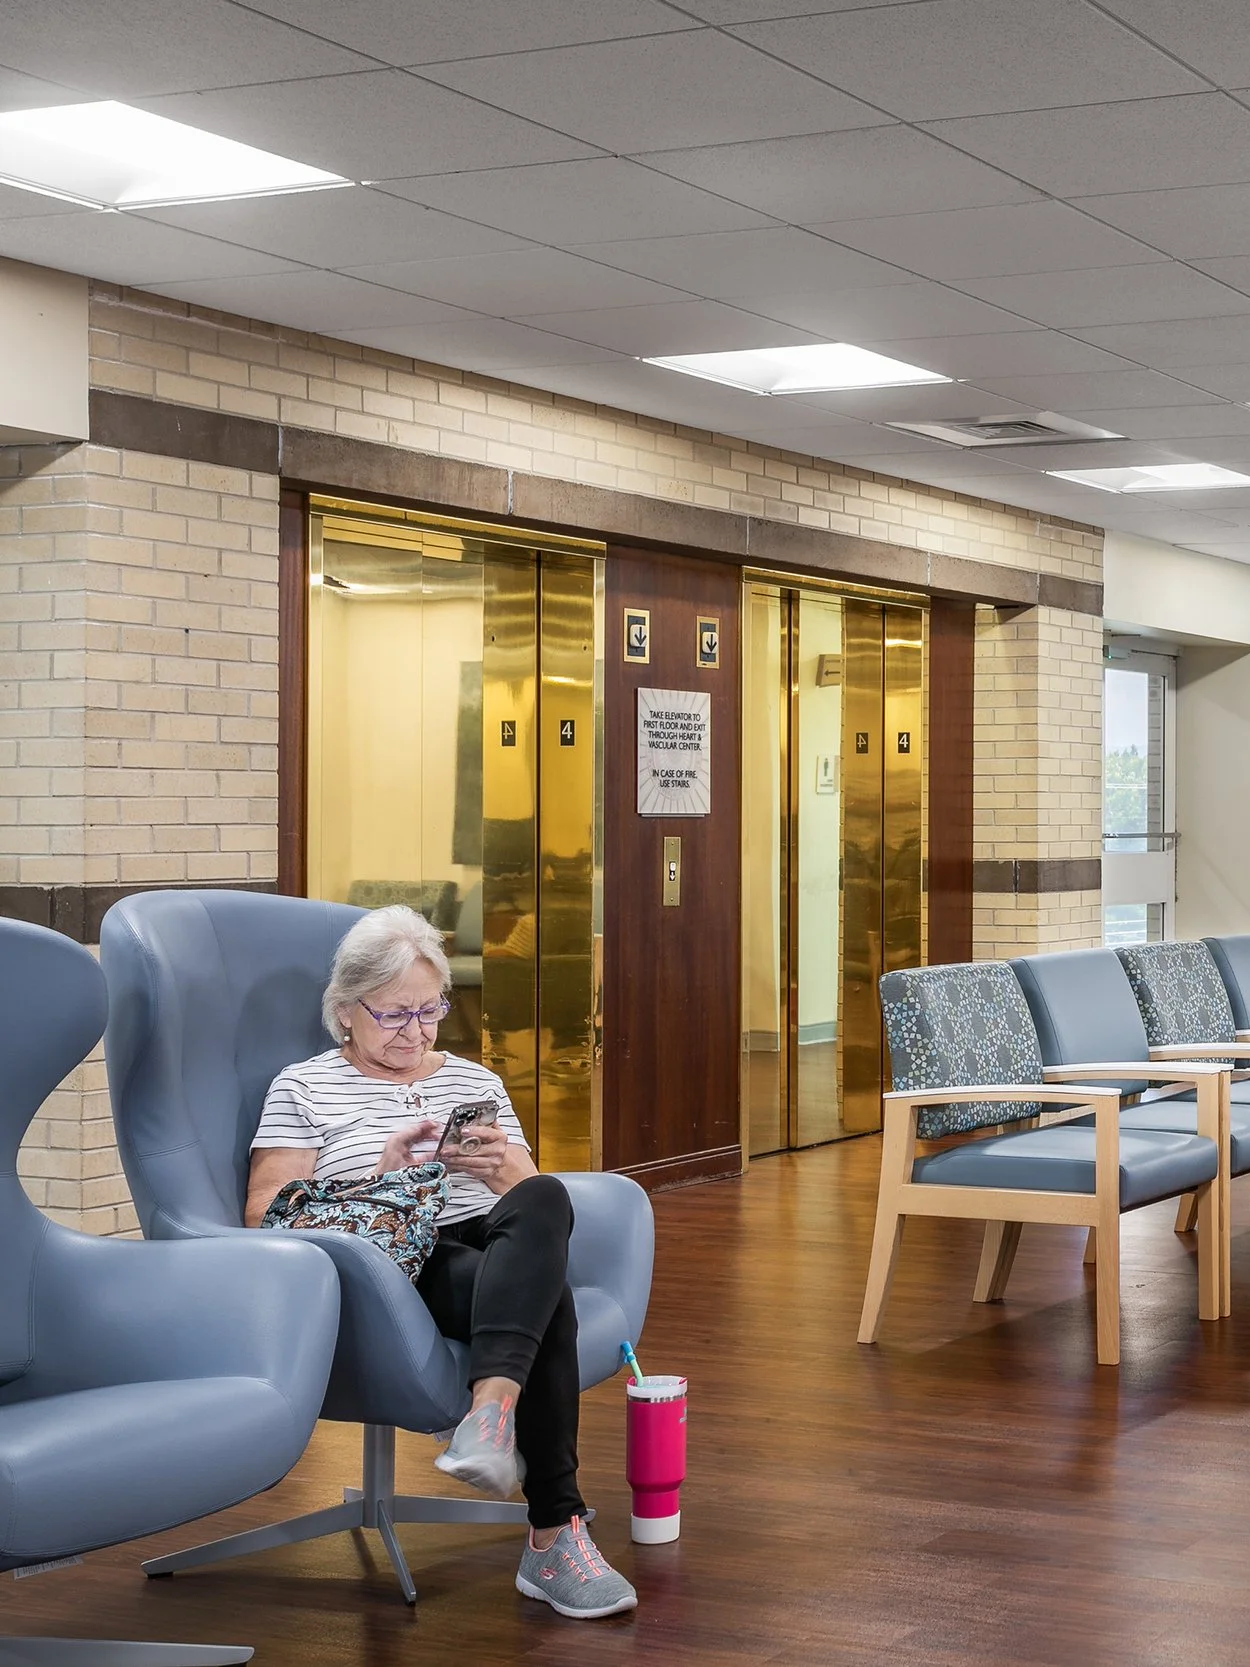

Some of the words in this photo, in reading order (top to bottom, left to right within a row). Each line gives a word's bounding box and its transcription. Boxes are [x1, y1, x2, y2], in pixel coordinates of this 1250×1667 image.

[650, 711, 663, 719] TAKE
[665, 711, 692, 721] ELEVATOR
[644, 720, 658, 729] FIRST
[660, 721, 679, 730] FLOOR
[680, 722, 692, 730] AND
[562, 722, 572, 739] 4
[648, 731, 677, 740] THROUGH
[679, 732, 696, 740] HEART
[648, 741, 677, 750] VASCULAR
[899, 734, 908, 748] 4
[652, 769, 659, 777] IN
[660, 770, 675, 778] CASE
[676, 770, 684, 778] OF
[660, 780, 670, 788] USE
